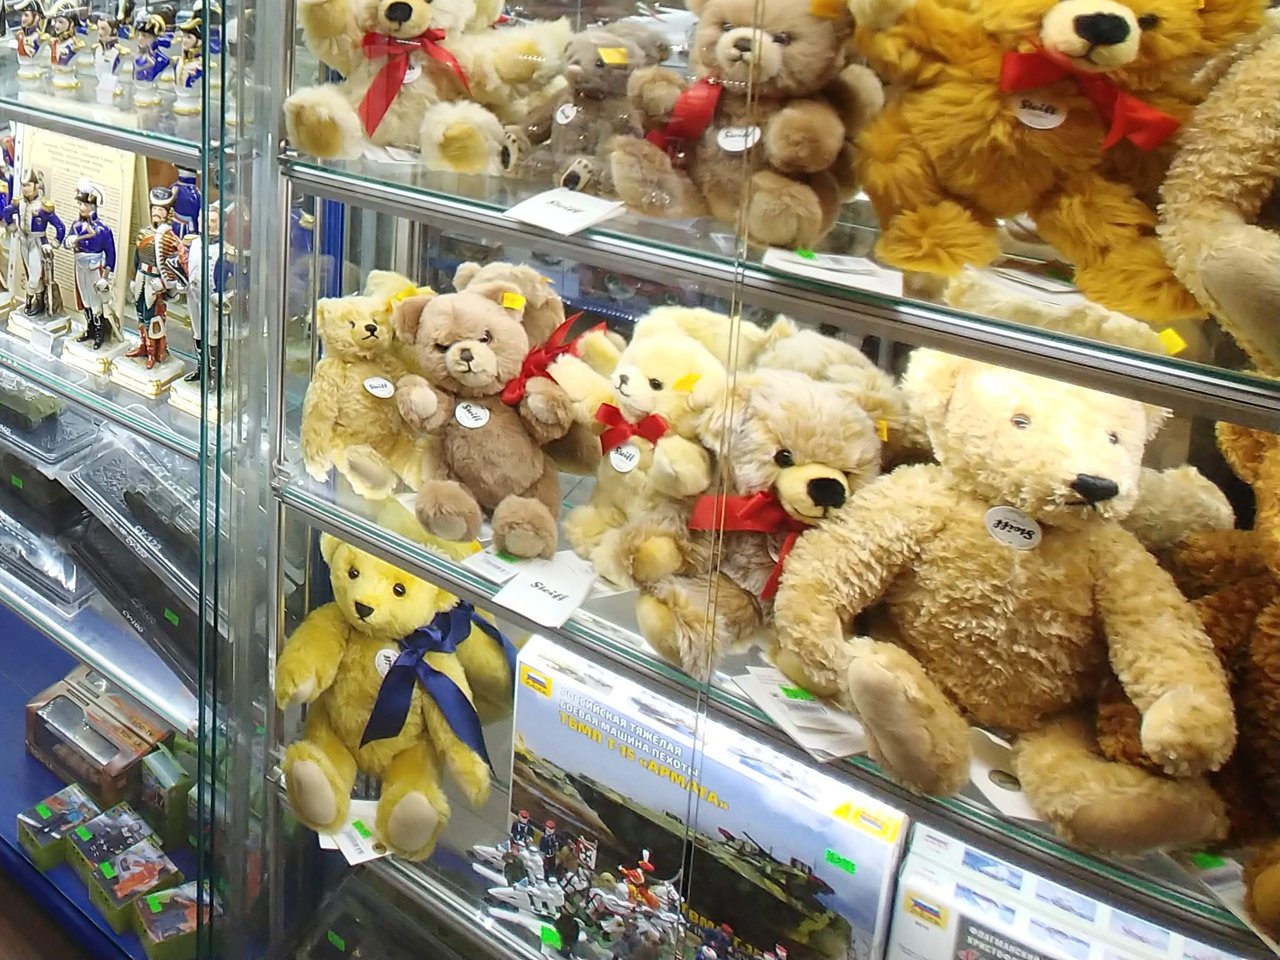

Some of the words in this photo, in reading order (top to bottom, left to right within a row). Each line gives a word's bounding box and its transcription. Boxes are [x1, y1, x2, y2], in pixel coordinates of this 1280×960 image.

[461, 400, 487, 423] Steiff
[134, 525, 162, 551] СУ-122
[531, 578, 569, 604] Steiff
[559, 701, 599, 726] БОЕВАЯ
[600, 719, 650, 755] МАШИНА
[651, 747, 699, 777] ПЕХОТЫ
[560, 686, 628, 730] РОССИЙСКАЯ
[630, 721, 683, 757] ТЯЖЕЛАЯ
[558, 711, 603, 745] ТБМП
[638, 755, 730, 812] «АРМАТА»
